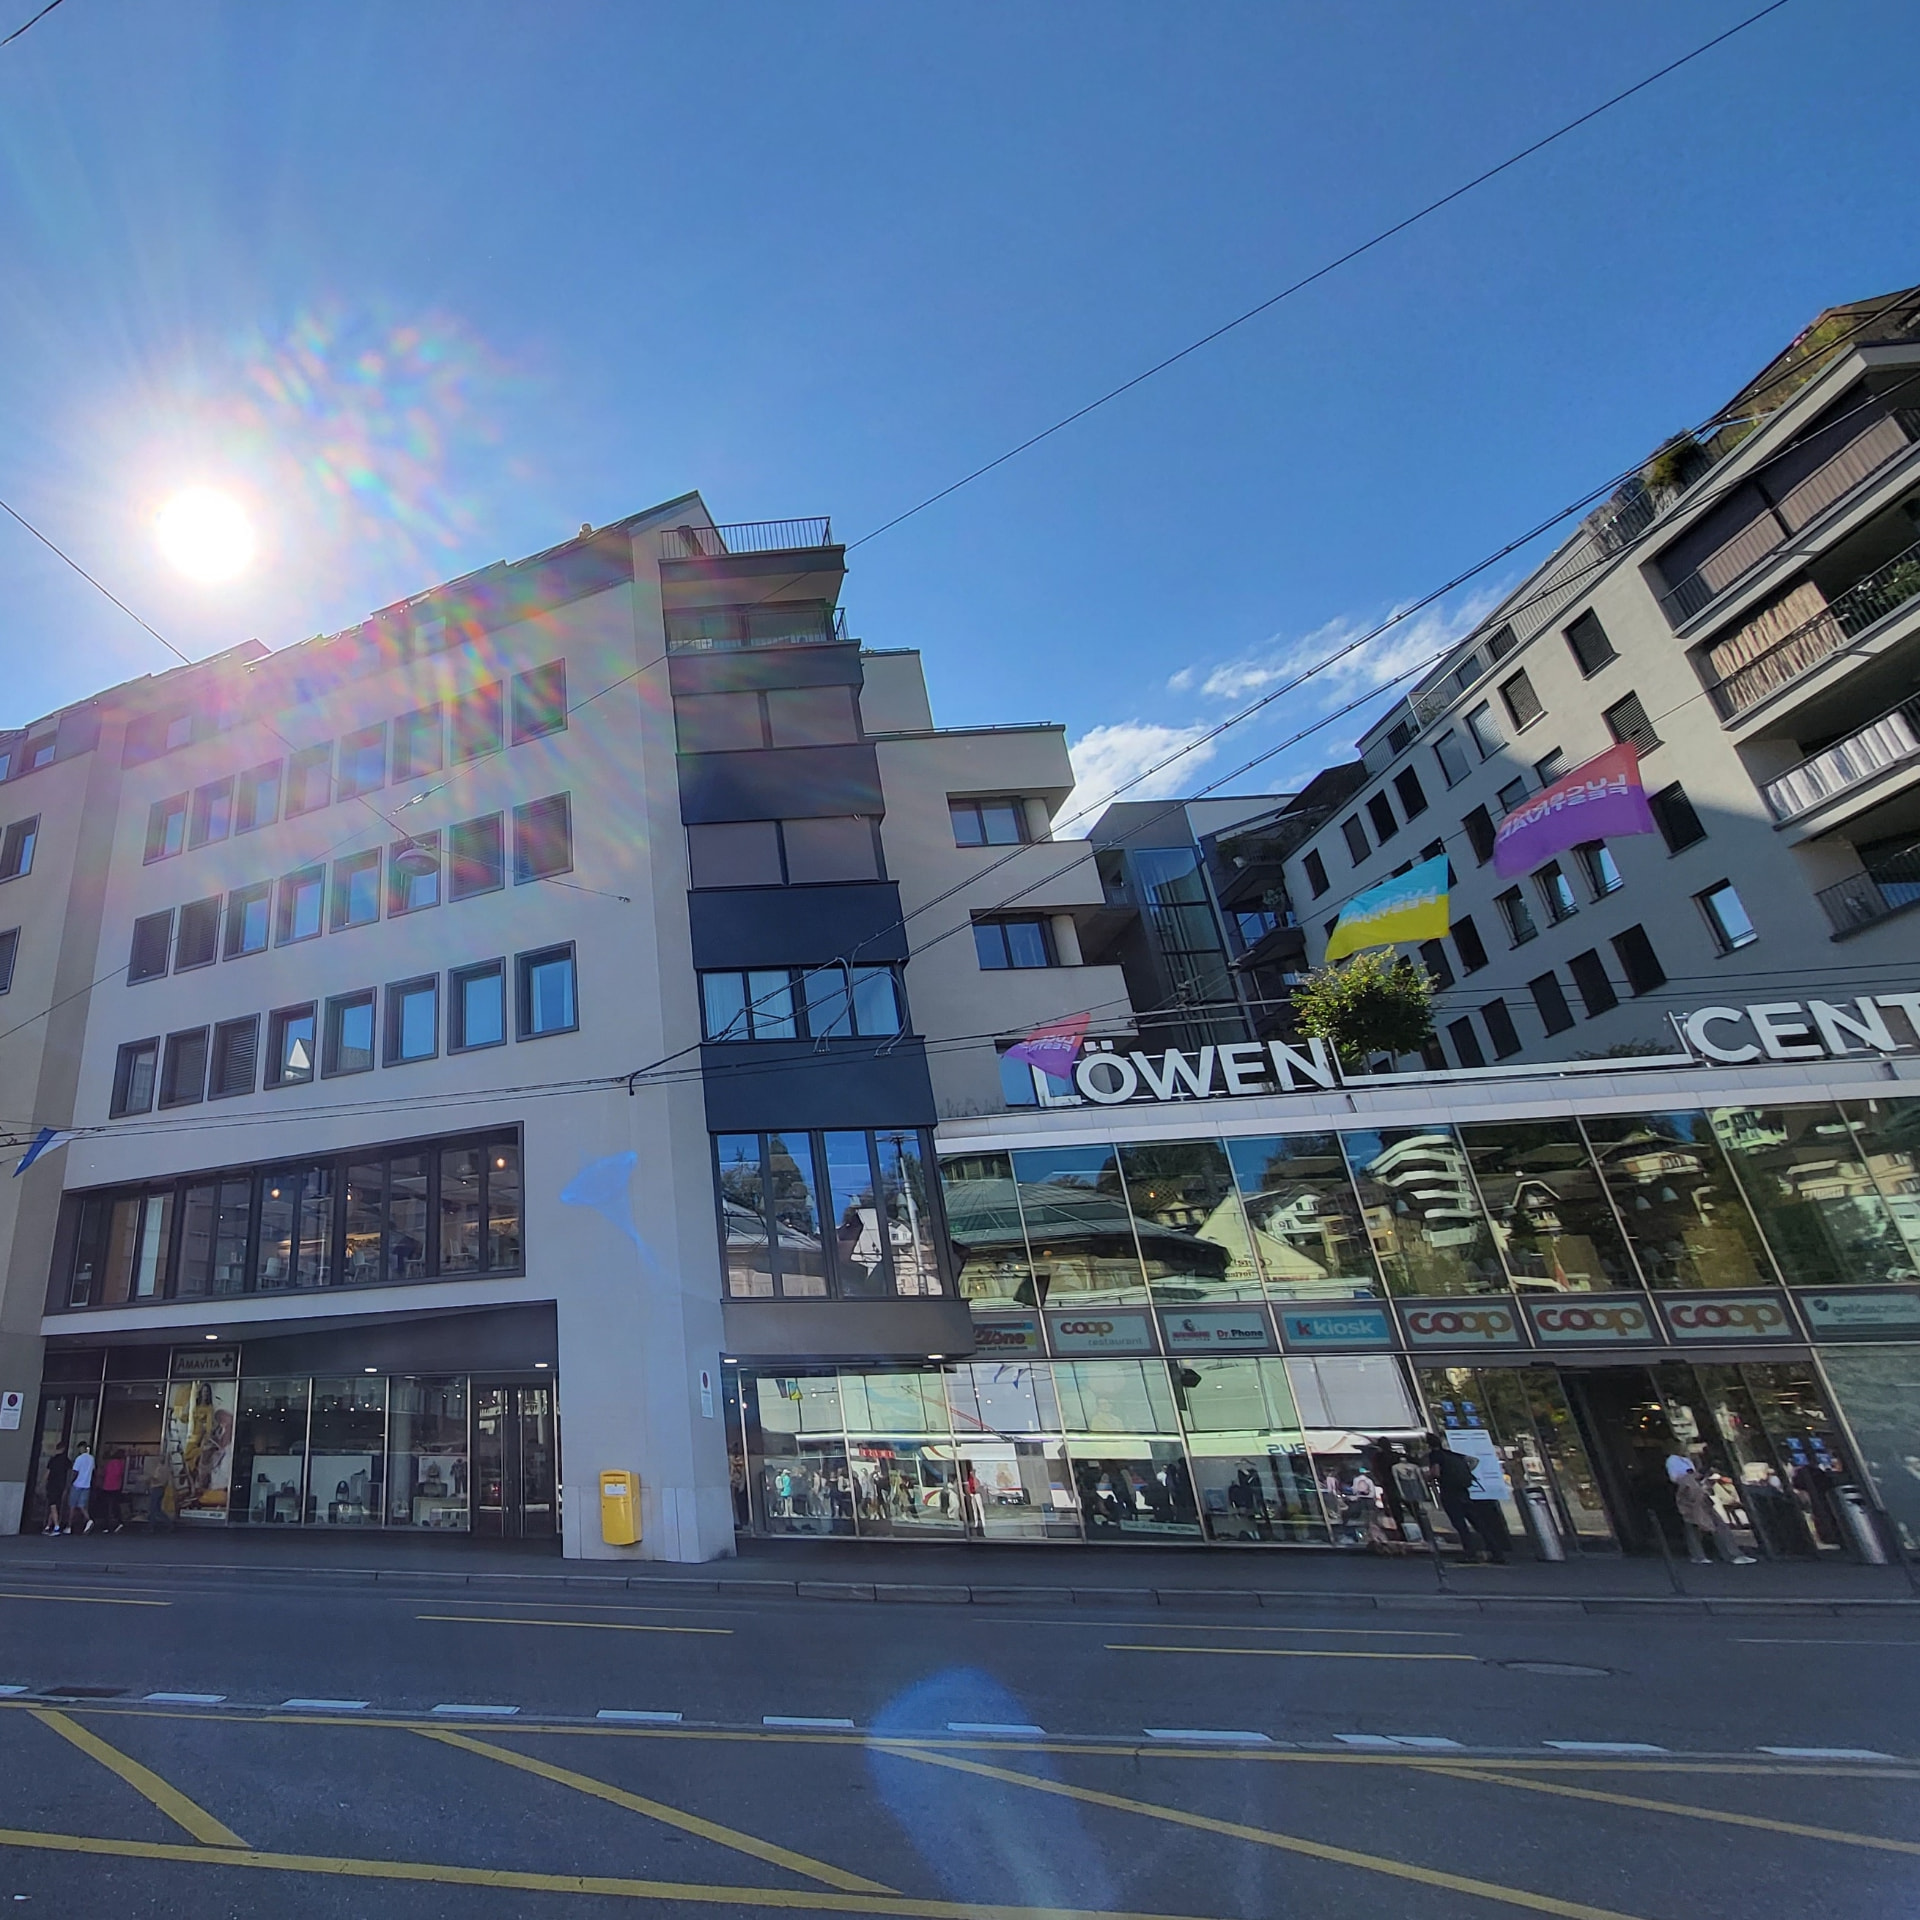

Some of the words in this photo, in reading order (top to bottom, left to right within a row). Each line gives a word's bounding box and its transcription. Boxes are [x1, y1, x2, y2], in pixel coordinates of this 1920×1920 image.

[1031, 1036, 1336, 1108] LÖWEN
[1060, 1321, 1114, 1336] coop
[1313, 1319, 1376, 1336] kiosk
[1408, 1310, 1513, 1339] coop
[1536, 1307, 1646, 1336] coop
[1669, 1304, 1784, 1333] coop
[1088, 1336, 1144, 1346] restaurant
